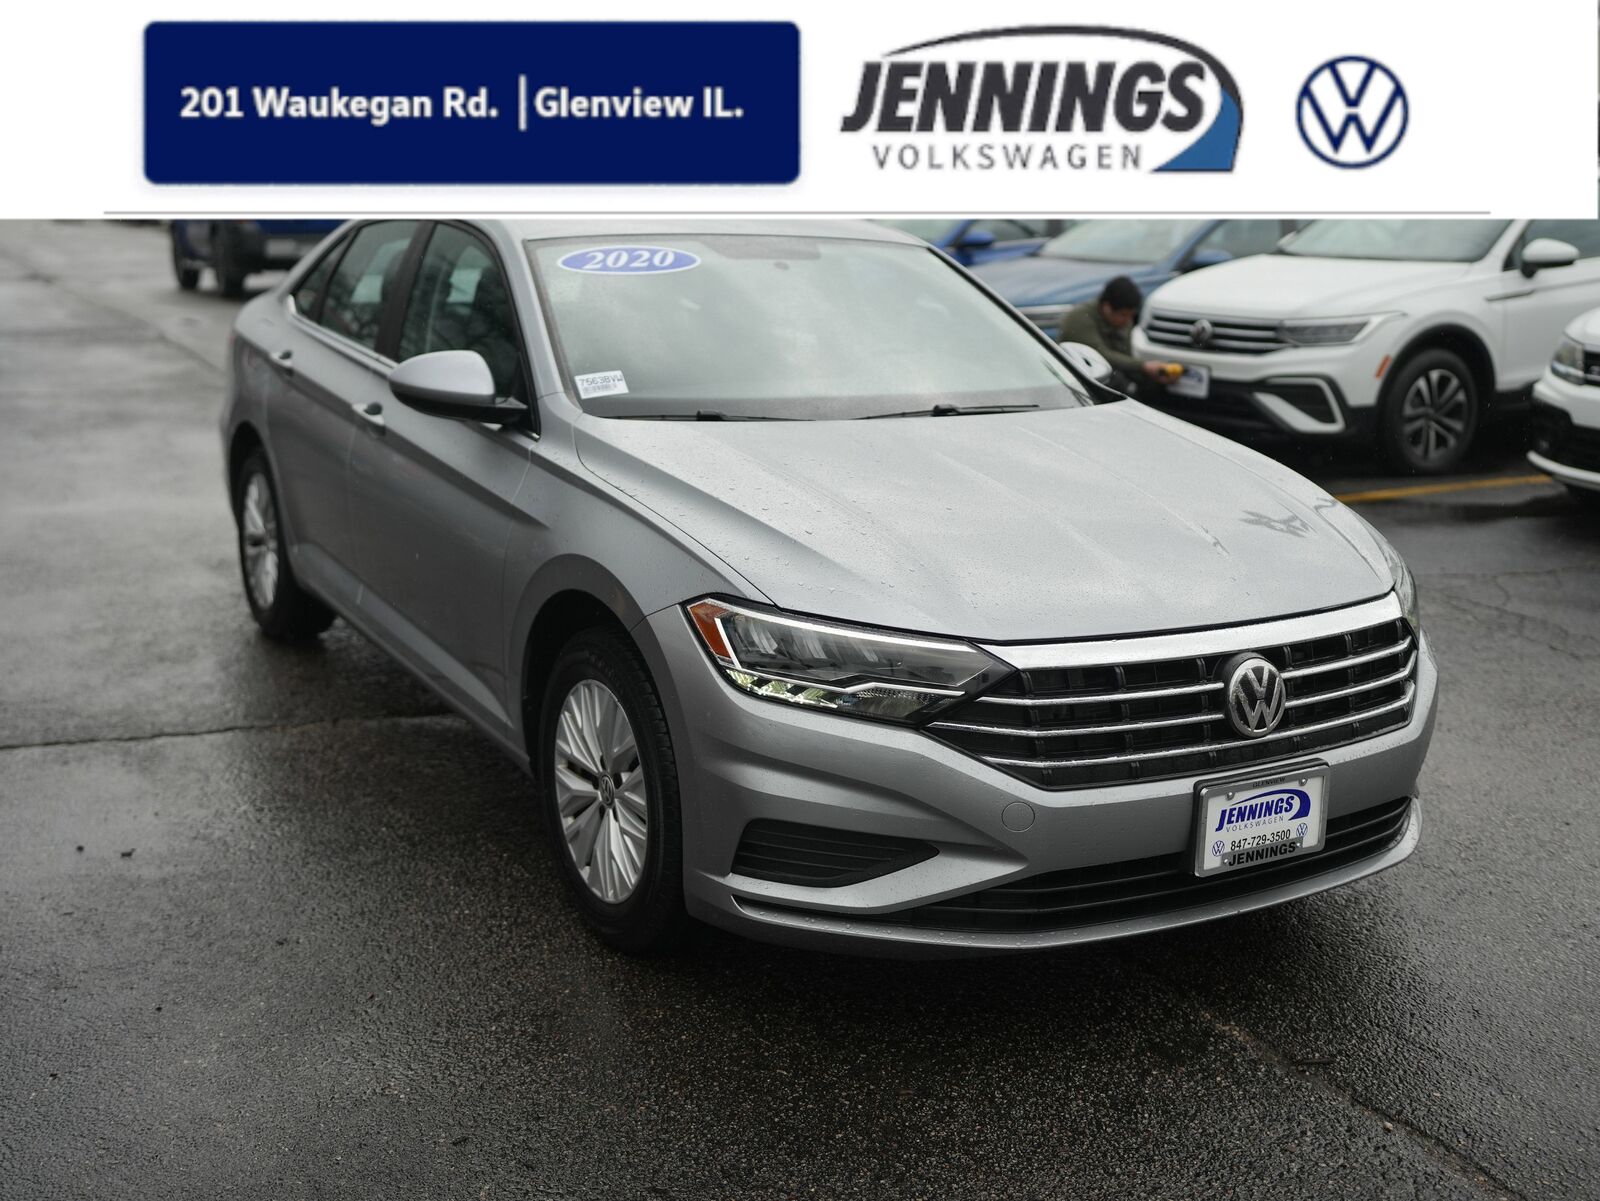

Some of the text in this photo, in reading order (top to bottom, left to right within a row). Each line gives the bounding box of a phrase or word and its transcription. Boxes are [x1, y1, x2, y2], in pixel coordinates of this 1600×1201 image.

[582, 249, 675, 270] 2020
[1215, 796, 1295, 832] JENNINGS
[1225, 815, 1284, 833] VOLKSWAGEN
[1230, 829, 1291, 851] 847-729-3500
[1228, 841, 1297, 867] JENNINGS
